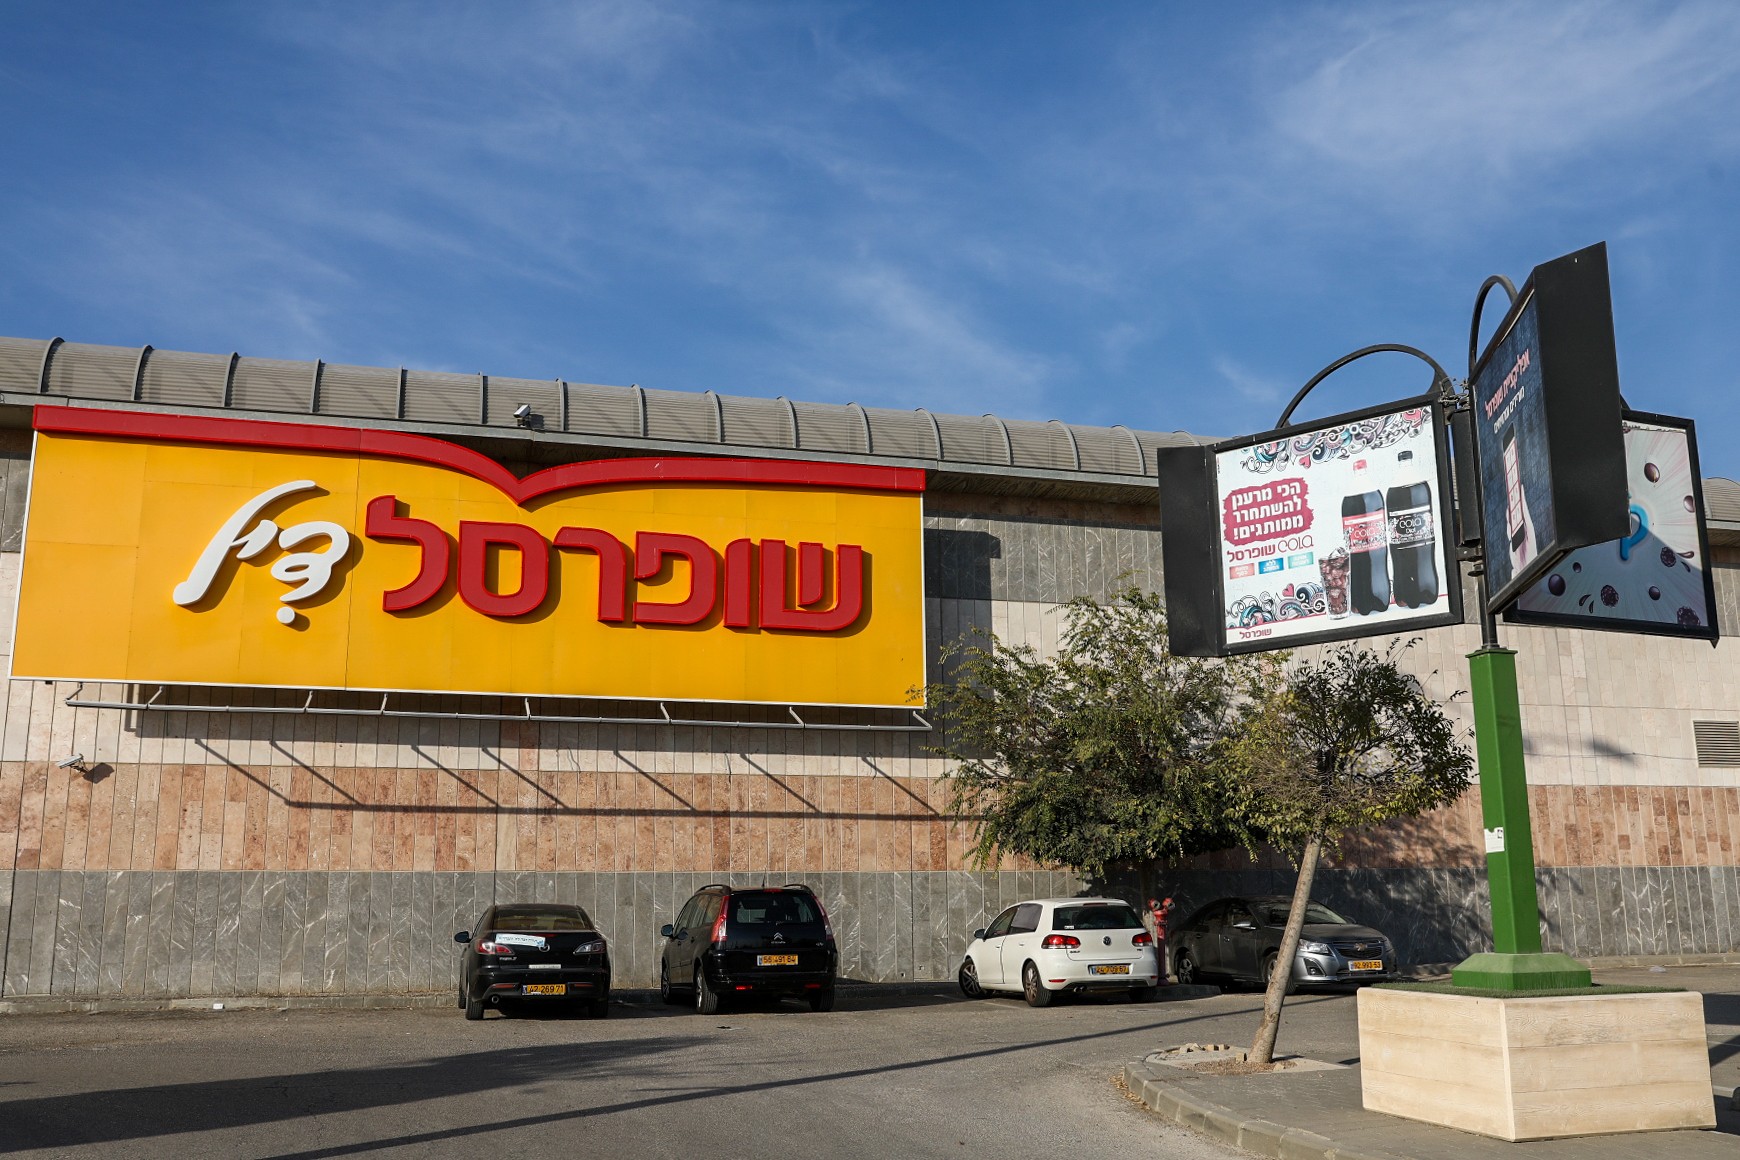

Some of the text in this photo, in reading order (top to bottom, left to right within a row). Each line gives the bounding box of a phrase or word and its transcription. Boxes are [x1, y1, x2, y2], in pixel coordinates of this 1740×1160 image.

[1231, 482, 1301, 511] הכי מרענן
[1232, 495, 1302, 523] להשתחרר
[1233, 515, 1304, 540] ממותגים!
[364, 494, 864, 632] שופרסל
[1226, 544, 1276, 563] שופרסל
[1239, 628, 1272, 640] שופרסל
